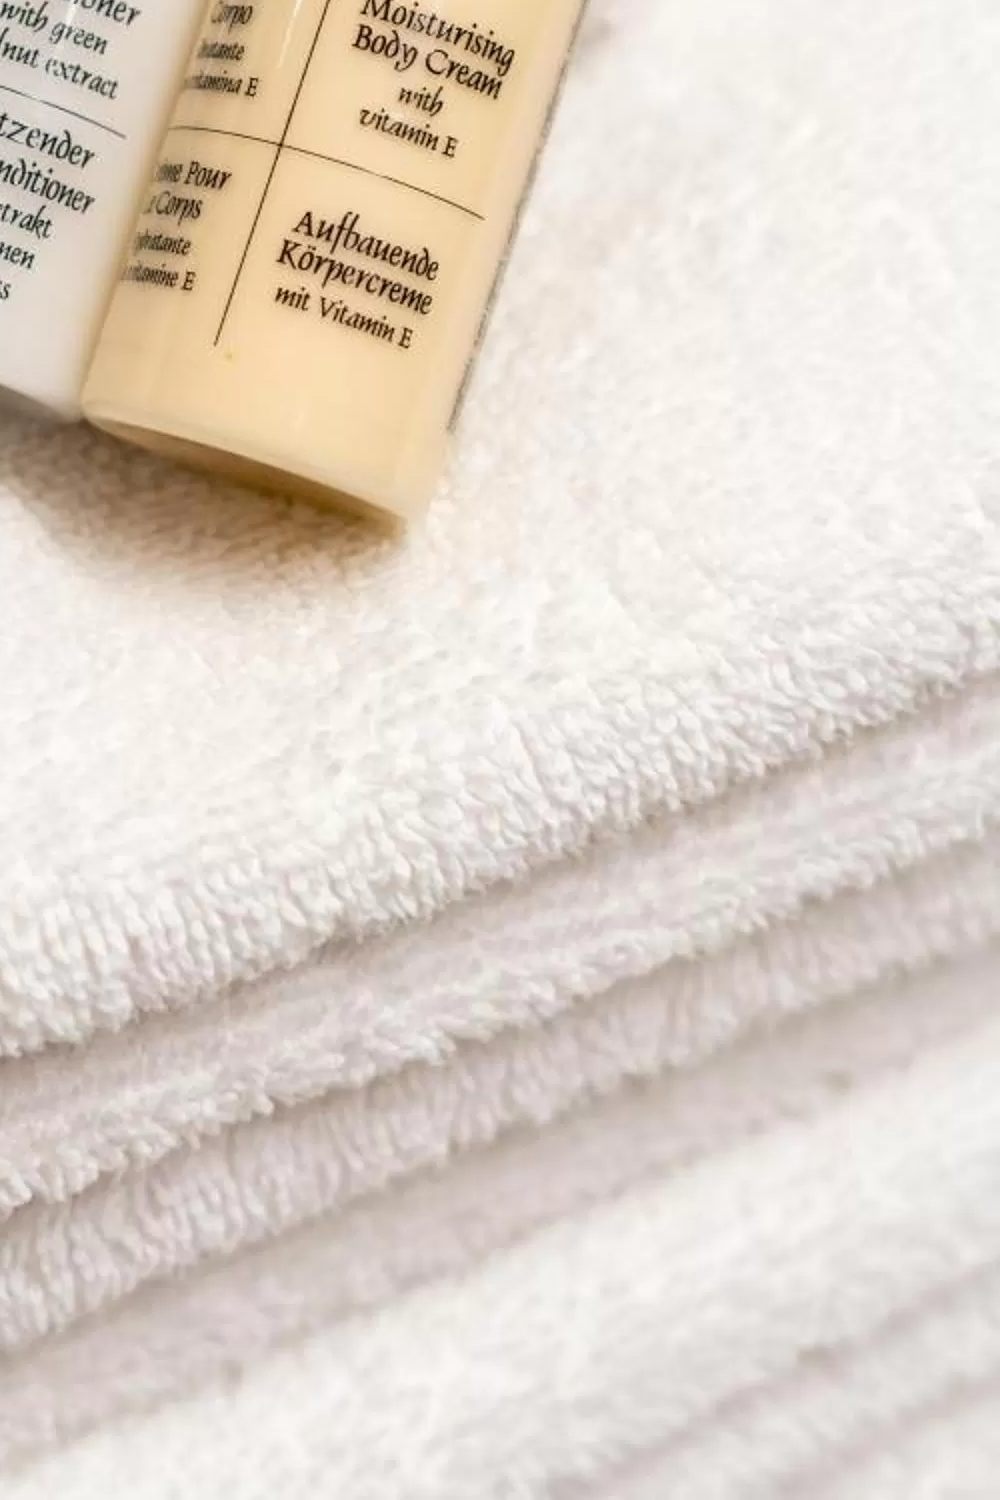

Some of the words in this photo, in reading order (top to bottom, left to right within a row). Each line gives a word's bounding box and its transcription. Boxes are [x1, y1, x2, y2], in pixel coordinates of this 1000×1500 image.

[0, 0, 48, 33] with
[49, 21, 109, 56] green
[45, 57, 119, 100] extract
[352, 24, 418, 71] Body
[425, 49, 504, 100] Cream
[244, 76, 259, 97] E
[398, 83, 444, 115] with
[359, 107, 440, 151] vitamin
[442, 135, 460, 158] E
[183, 160, 232, 190] Pour
[155, 190, 204, 226] Corps
[293, 211, 440, 281] Aufbauende
[181, 271, 197, 291] E
[276, 239, 434, 315] Körpercreme
[274, 285, 310, 312] mit
[319, 297, 395, 341] Vitamin
[397, 328, 414, 349] E
